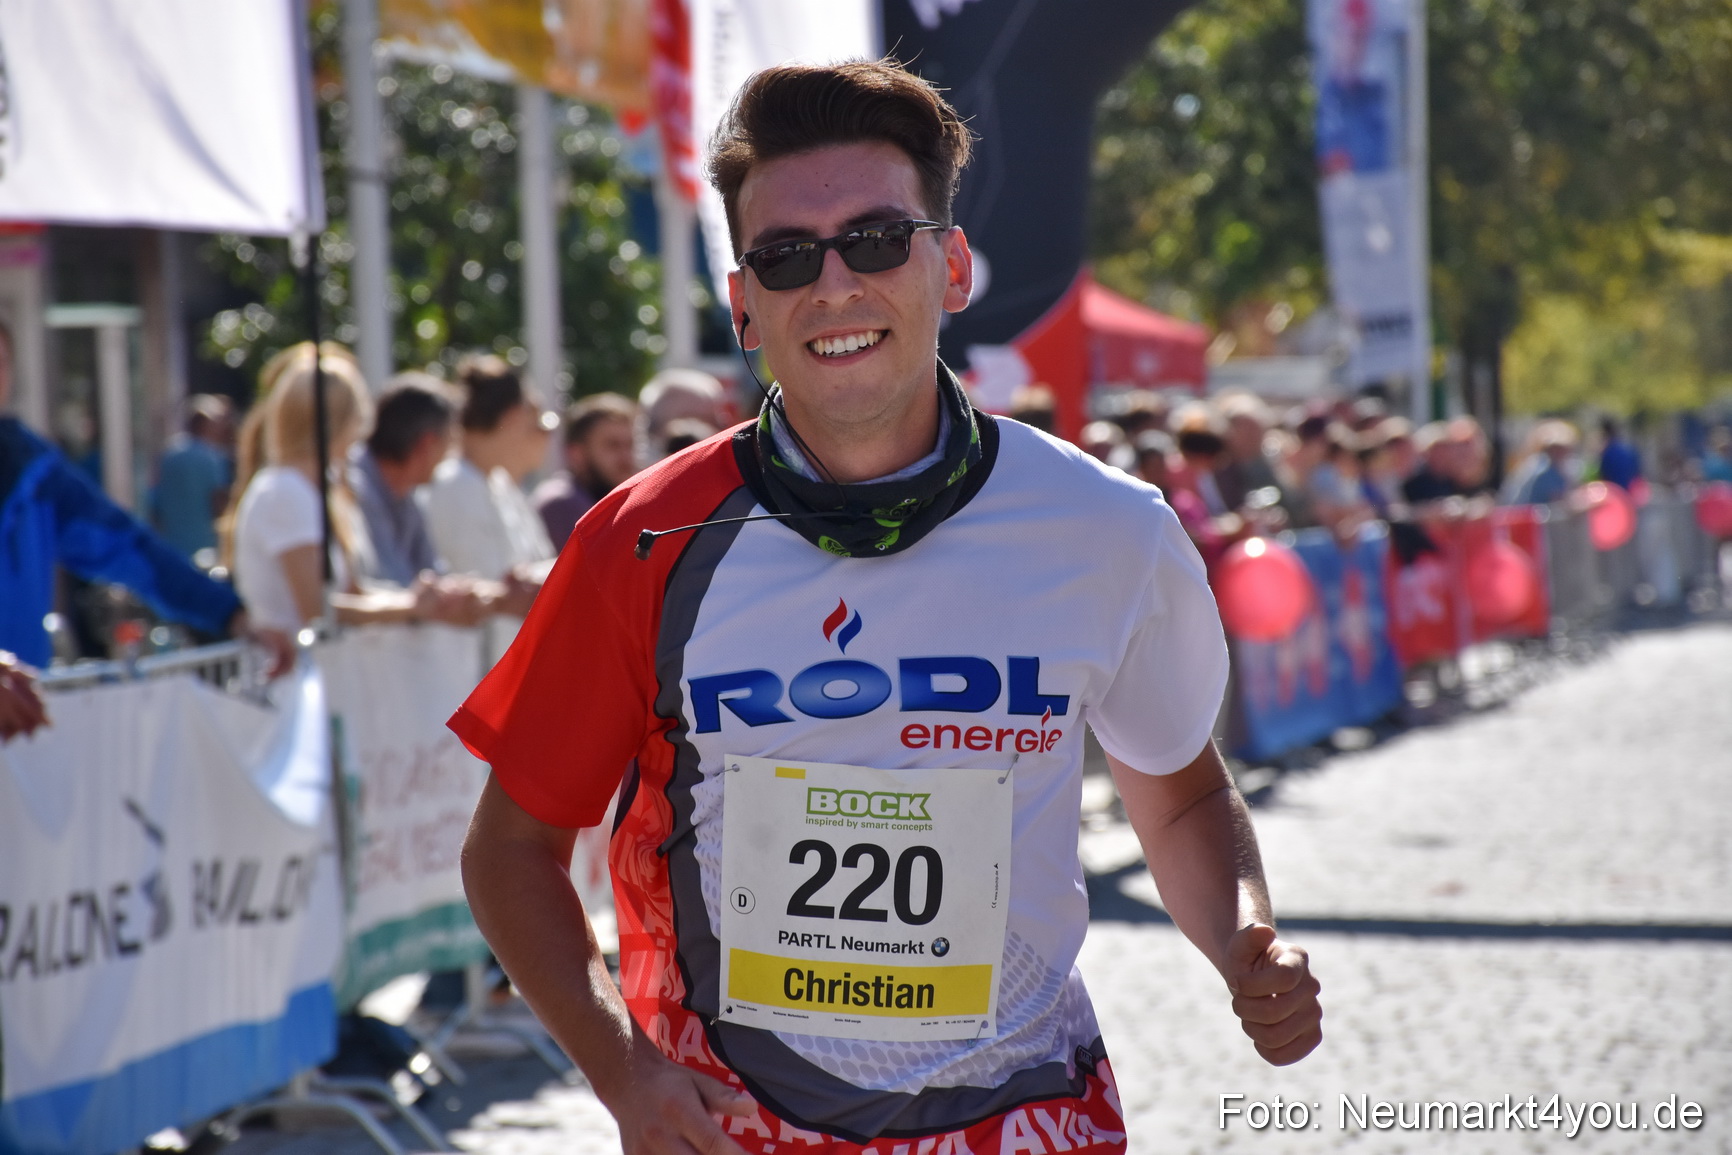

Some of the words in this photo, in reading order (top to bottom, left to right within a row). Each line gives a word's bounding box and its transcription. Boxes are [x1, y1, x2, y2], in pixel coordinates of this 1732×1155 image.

[806, 787, 933, 821] BOCK
[805, 815, 844, 828] inspired
[846, 818, 859, 830] by
[860, 821, 889, 830] smart
[891, 822, 933, 833] concepts
[786, 839, 943, 926] 220
[737, 893, 748, 908] D
[778, 930, 836, 950] PARTL
[841, 935, 925, 955] Neumarkt
[783, 967, 935, 1009] Christian
